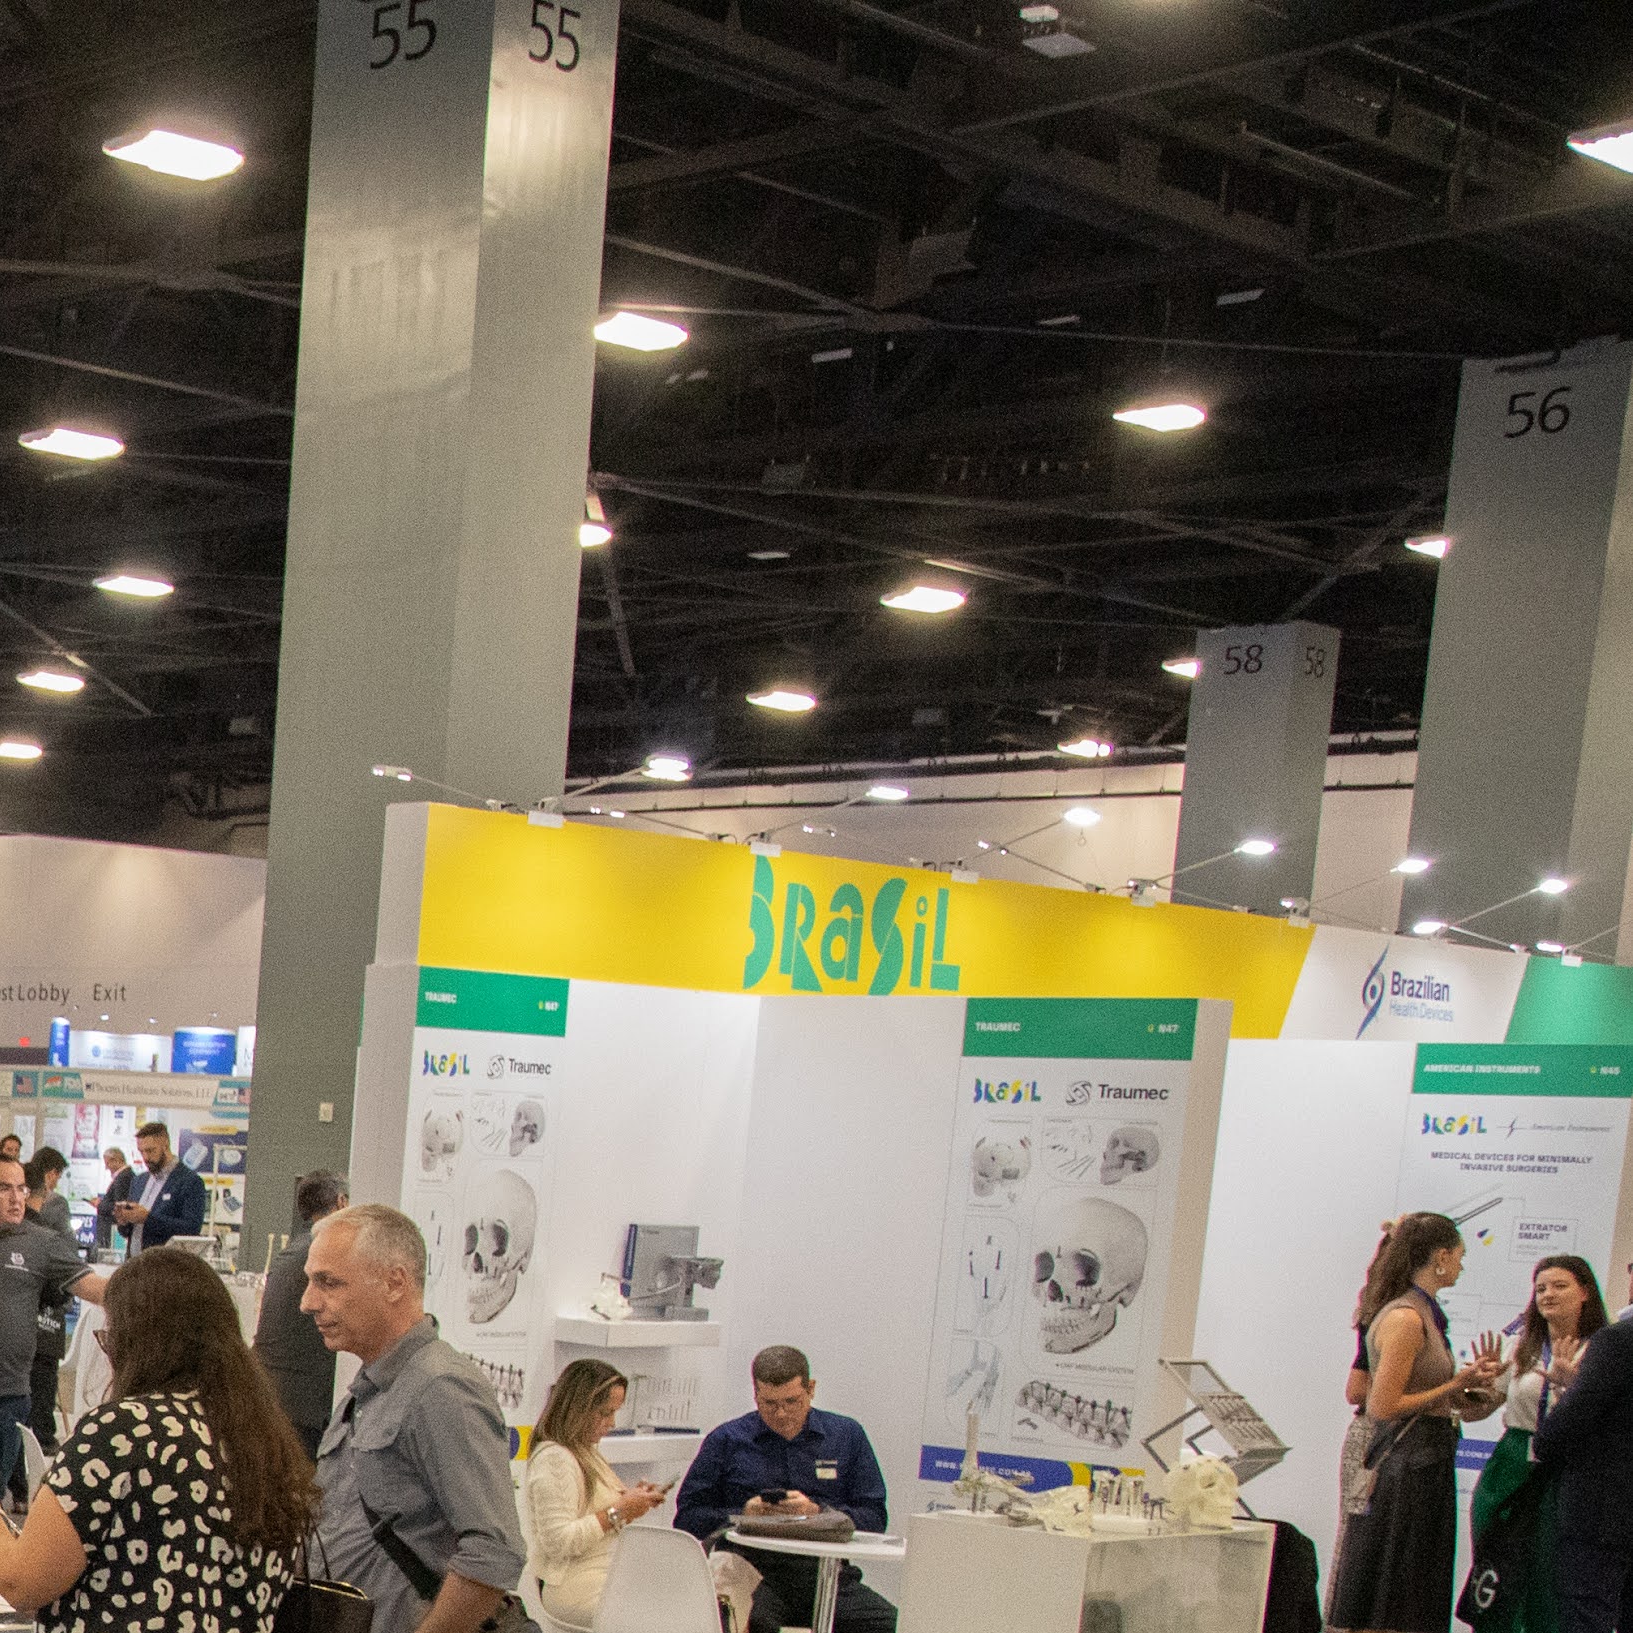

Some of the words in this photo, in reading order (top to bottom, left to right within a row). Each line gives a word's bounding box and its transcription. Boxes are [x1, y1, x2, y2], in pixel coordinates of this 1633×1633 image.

[369, 0, 436, 69] 55
[528, 0, 582, 72] 55
[1504, 386, 1572, 438] 56
[1223, 644, 1264, 676] 58
[92, 983, 128, 1001] Exit
[1391, 970, 1450, 1002] Brazilian
[17, 984, 71, 1006] Lobby
[975, 1021, 1021, 1032] TRAUMEC
[508, 1058, 552, 1075] Traumec
[1423, 1064, 1472, 1074] AMERICAN
[1475, 1064, 1541, 1074] INSTRUMENTS
[1098, 1084, 1169, 1101] Traumec
[1430, 1151, 1472, 1160] MEDICAL
[1474, 1152, 1514, 1162] DEVICES
[1516, 1153, 1536, 1162] FOR
[1537, 1154, 1593, 1165] MINIMALLY
[1459, 1163, 1504, 1173] INVASIVE
[1505, 1165, 1559, 1175] SURGERIES
[1518, 1222, 1568, 1233] EXTRATOR
[1518, 1232, 1551, 1241] SMART
